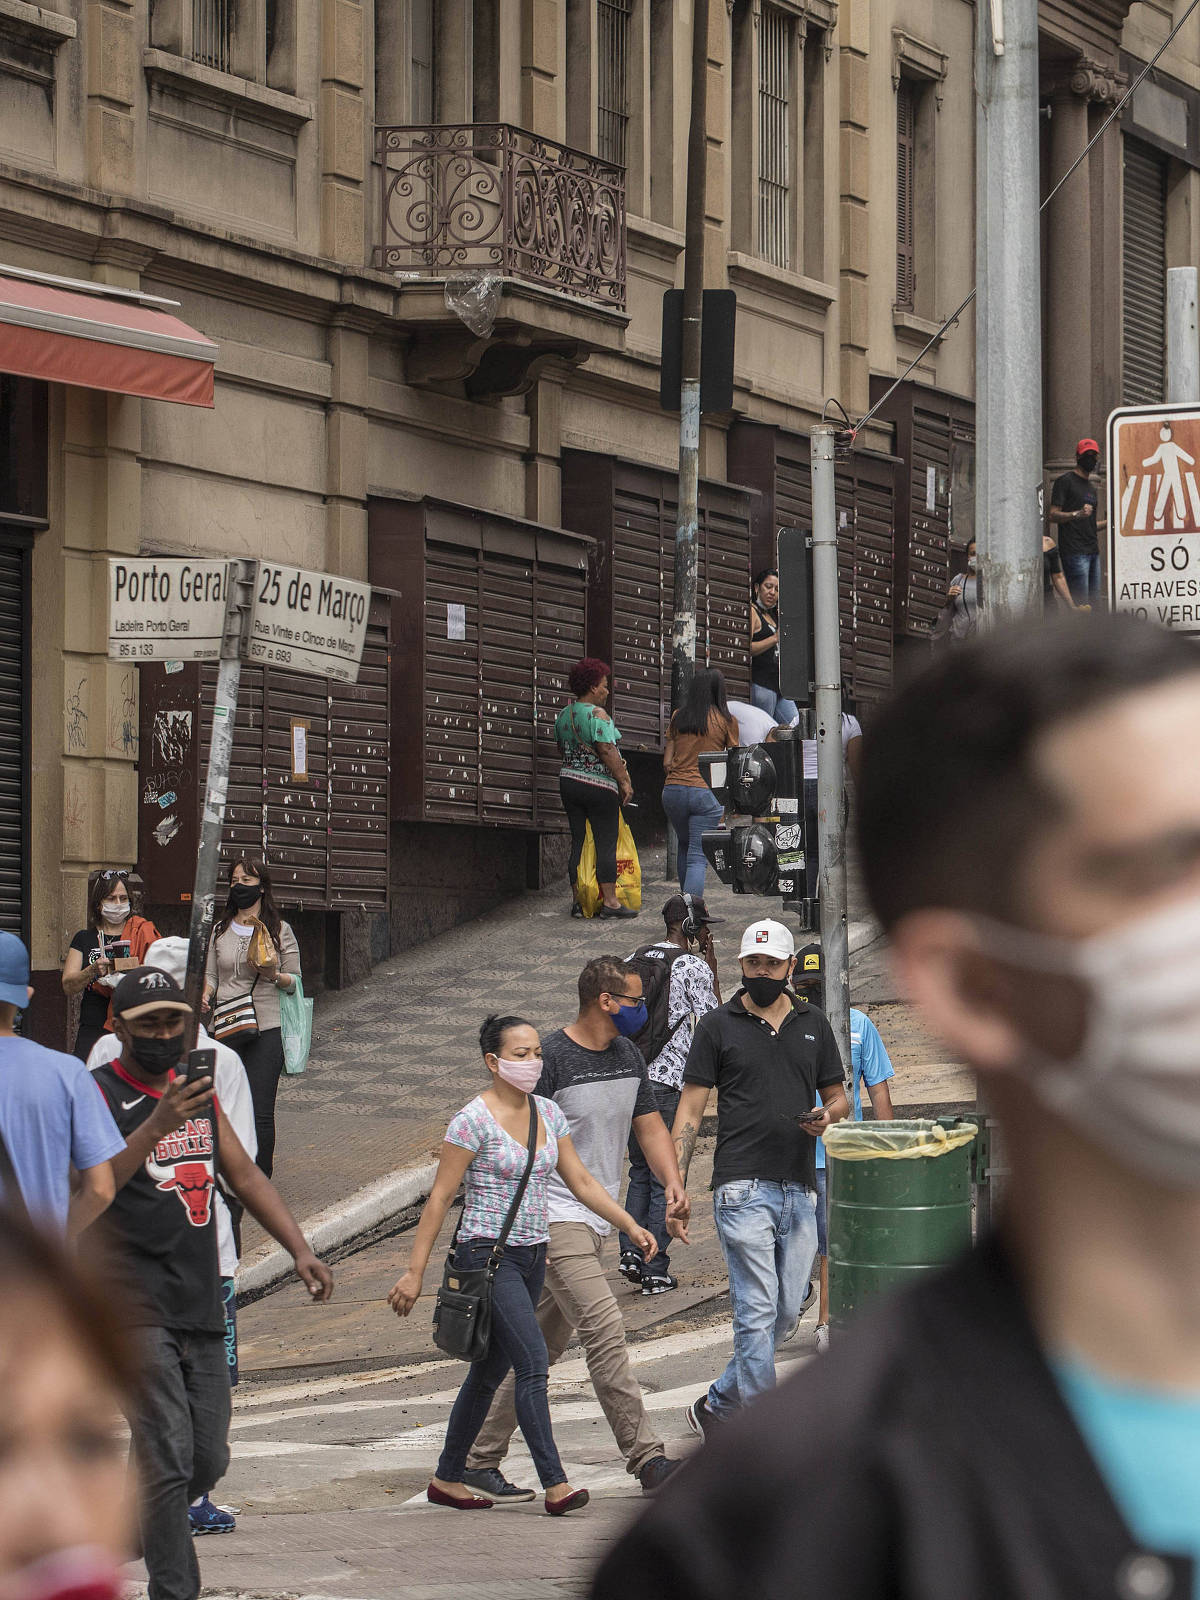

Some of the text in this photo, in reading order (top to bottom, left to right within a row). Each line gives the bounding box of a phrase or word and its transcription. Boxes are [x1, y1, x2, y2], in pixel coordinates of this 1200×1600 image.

[1150, 537, 1190, 572] SÓ
[115, 563, 228, 602] Porto Geral
[258, 568, 365, 633] 25 de Março
[115, 619, 190, 632] Ladeira Porto Geral
[253, 619, 356, 656] Rua Vinte e Cinco de Março
[119, 643, 130, 656] 95
[139, 643, 154, 656] 133
[250, 642, 292, 663] 637 a 693
[155, 1135, 213, 1161] BULLS
